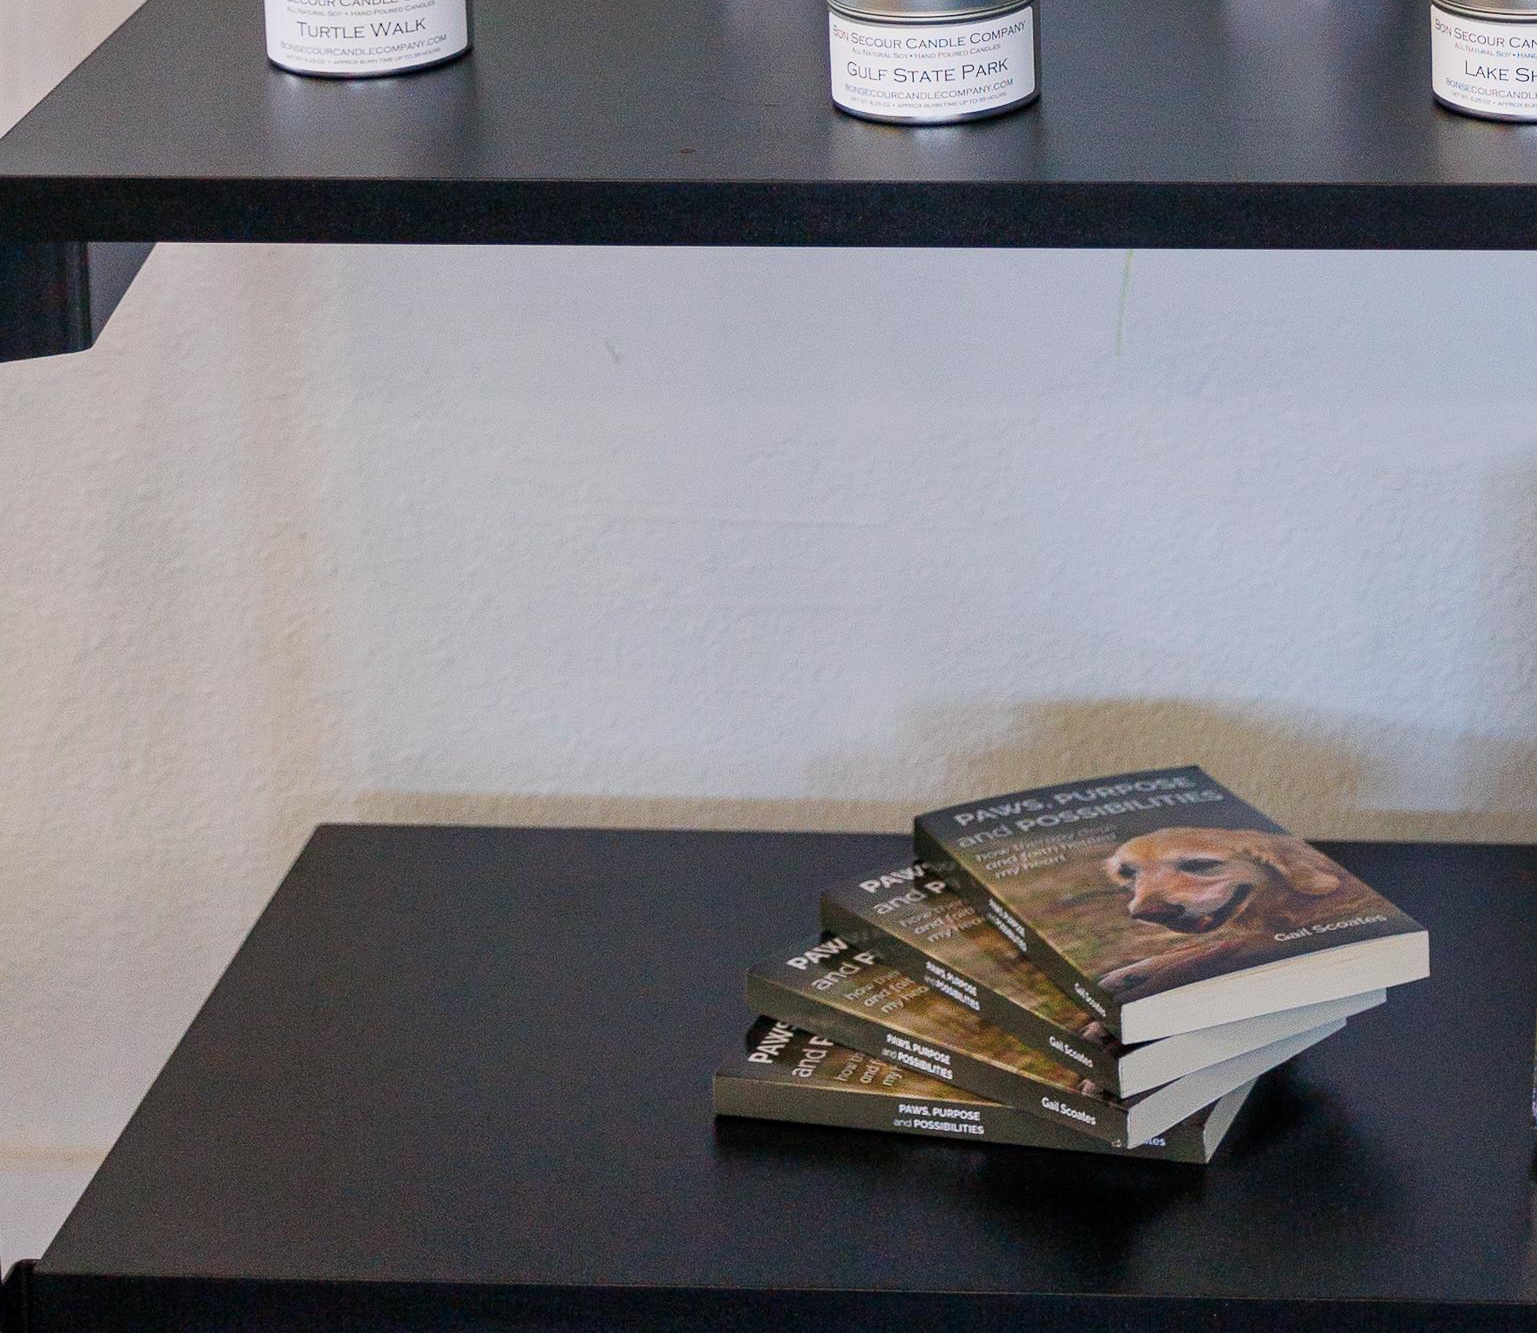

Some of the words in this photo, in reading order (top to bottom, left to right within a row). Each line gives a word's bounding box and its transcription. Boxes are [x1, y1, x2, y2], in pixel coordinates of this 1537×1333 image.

[297, 21, 365, 39] TURTLE
[371, 18, 427, 37] WALK
[847, 61, 887, 81] GULF
[894, 67, 956, 84] STATE
[962, 58, 1009, 80] PARK
[1465, 60, 1510, 81] LAKE
[872, 888, 928, 915] and
[1274, 928, 1313, 941] Gail
[1312, 914, 1387, 934] Scoates
[811, 962, 862, 991] and
[898, 1052, 953, 1080] POSSIBILITIES
[912, 1043, 951, 1065] PURPOSE
[932, 1108, 981, 1121] PURPOSE
[1041, 1096, 1059, 1112] Gail
[1060, 1103, 1096, 1125] Scoates
[893, 1118, 912, 1128] and
[913, 1119, 985, 1134] POSSIBILITIES
